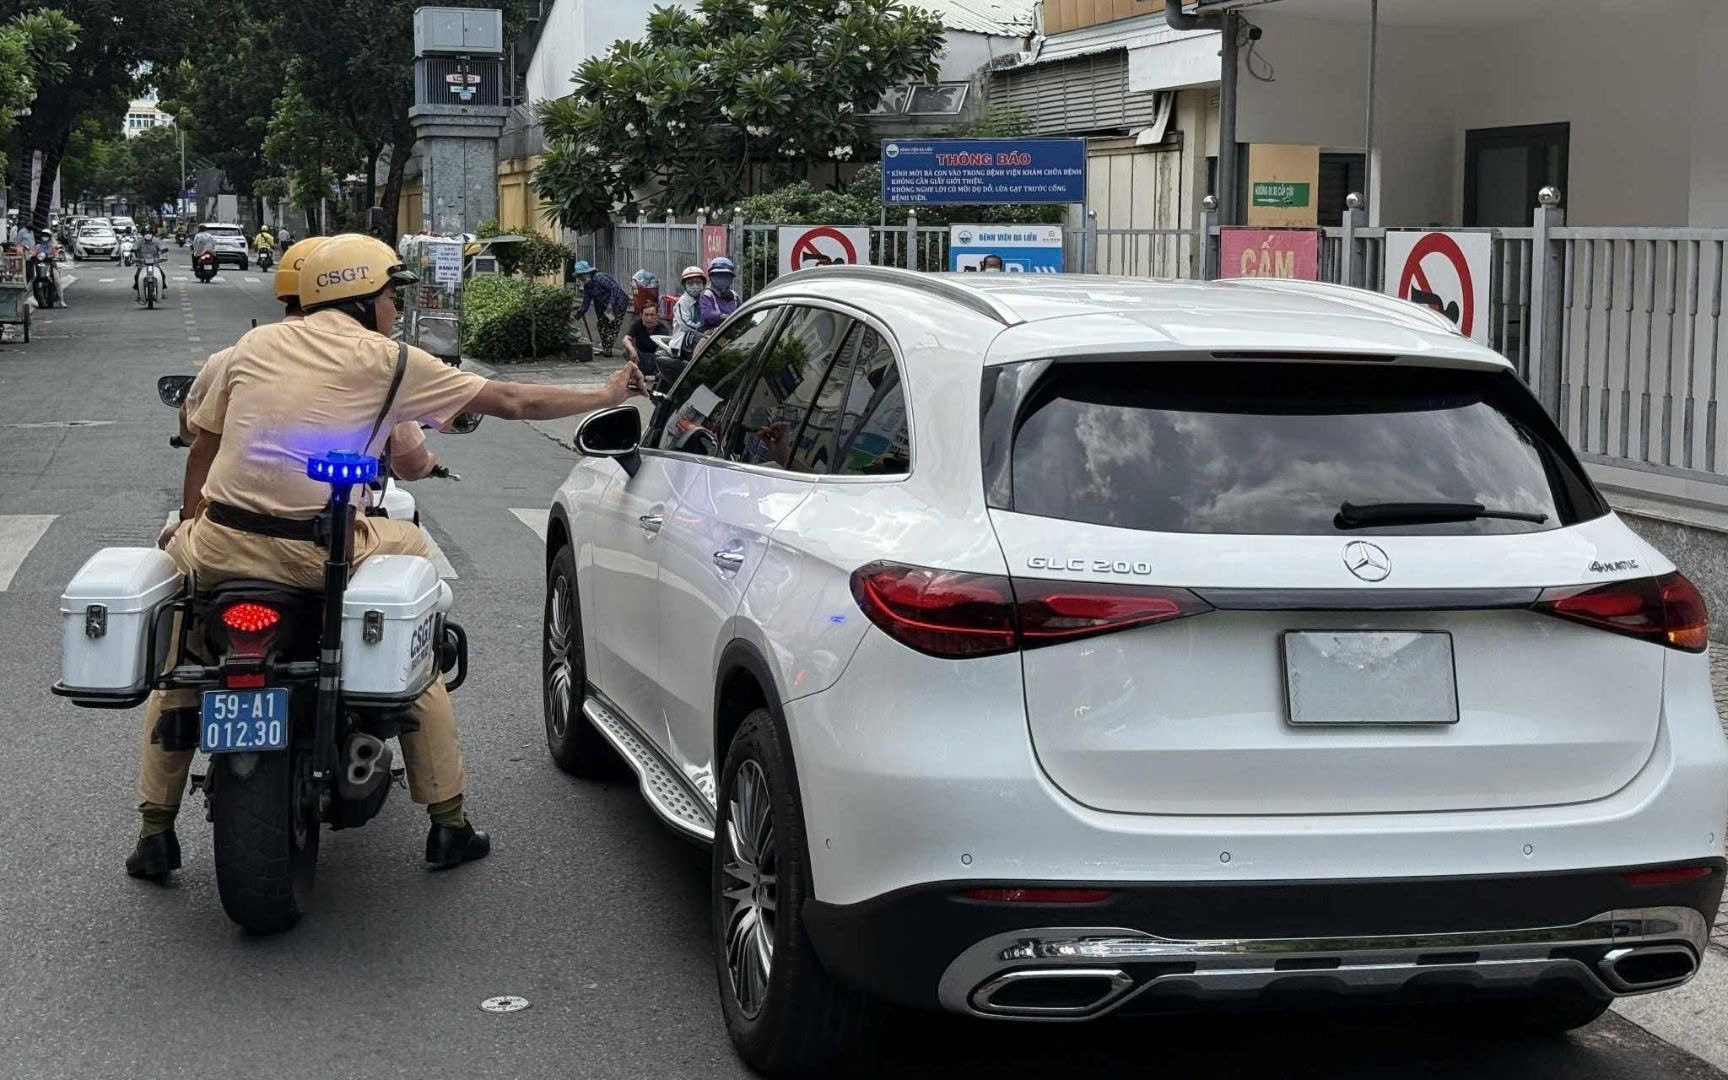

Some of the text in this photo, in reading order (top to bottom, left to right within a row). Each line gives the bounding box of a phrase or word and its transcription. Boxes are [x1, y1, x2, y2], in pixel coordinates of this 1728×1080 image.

[936, 151, 1032, 166] THÔNG BÁO
[1241, 234, 1294, 278] CẤM
[316, 266, 368, 287] CSGT
[1027, 555, 1152, 575] GLC 200
[410, 612, 434, 659] CSGT
[214, 693, 274, 719] 59-A1
[207, 720, 280, 748] 012.30
